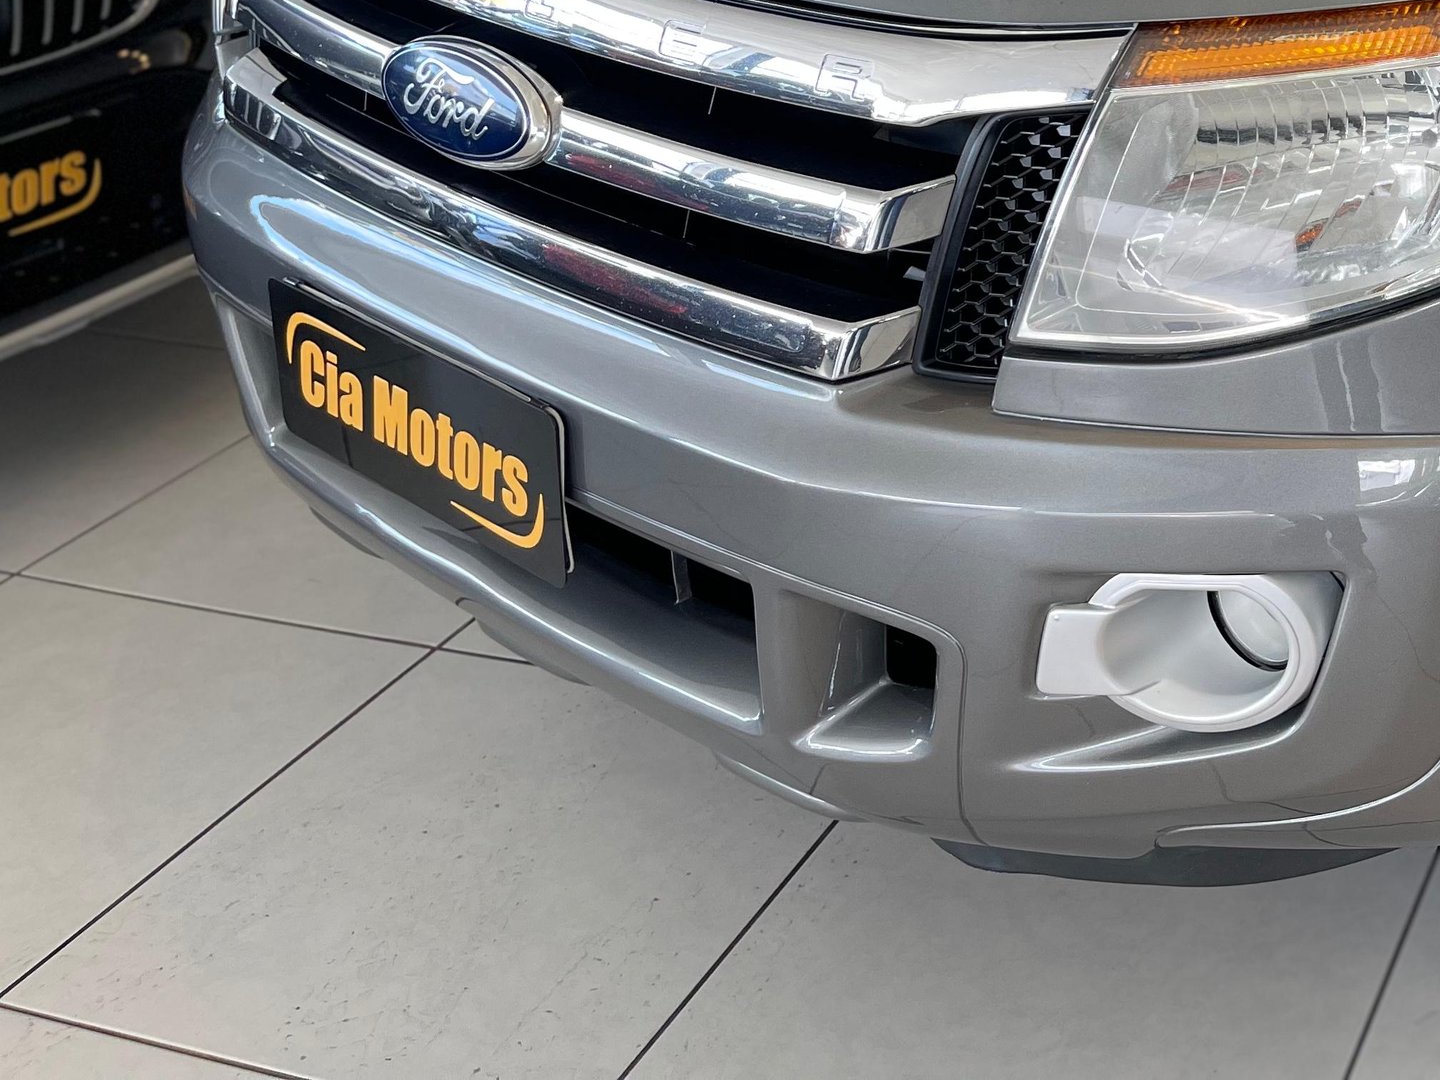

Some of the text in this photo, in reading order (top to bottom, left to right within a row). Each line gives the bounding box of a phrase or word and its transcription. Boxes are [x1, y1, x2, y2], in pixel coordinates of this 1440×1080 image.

[403, 57, 495, 140] Ford
[299, 339, 529, 517] Cia Motors
